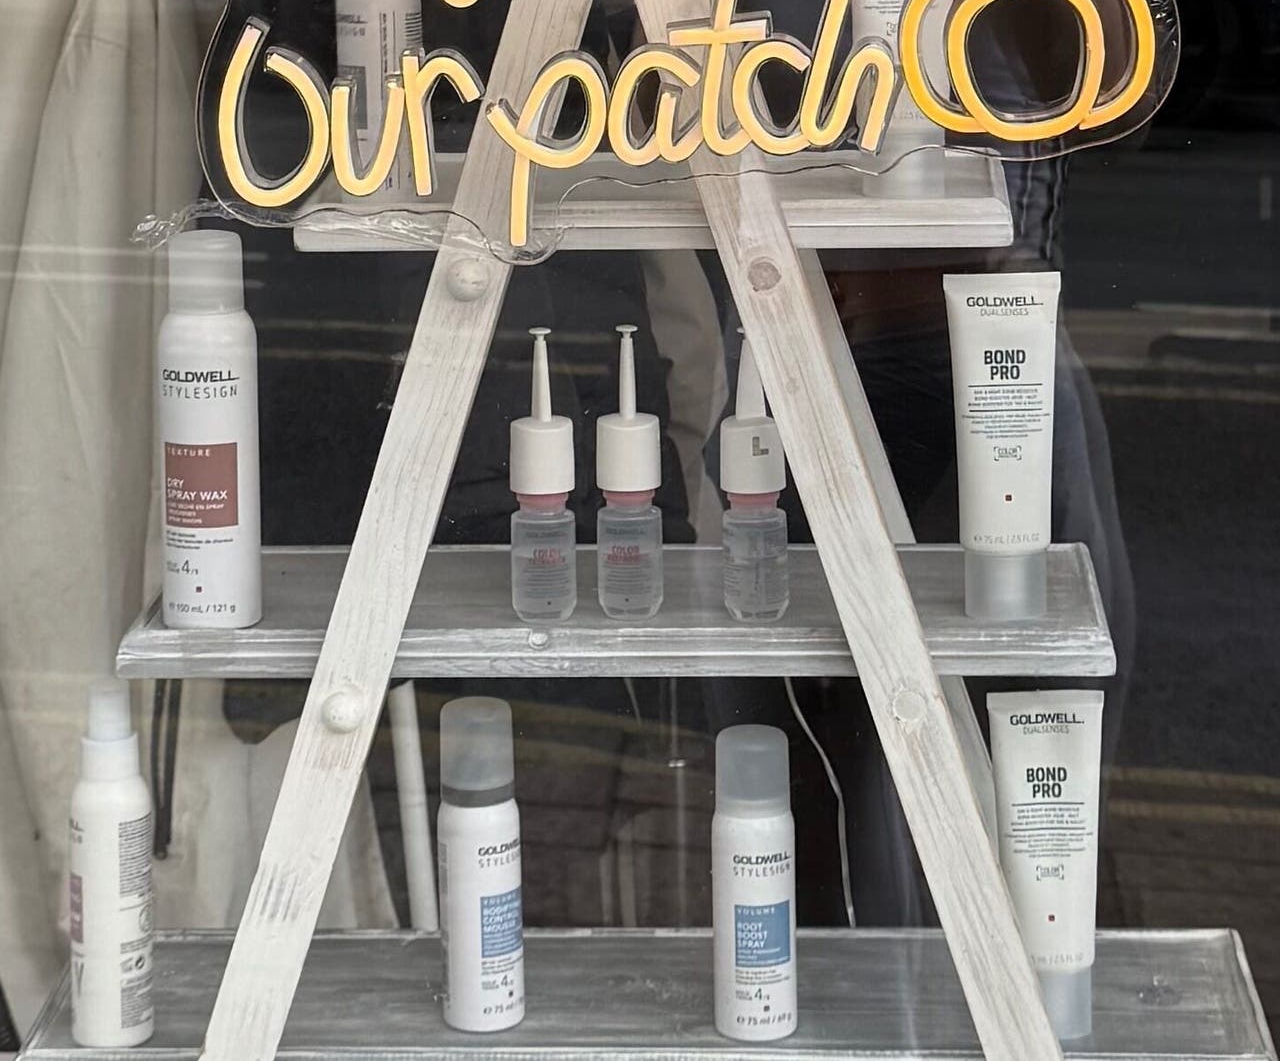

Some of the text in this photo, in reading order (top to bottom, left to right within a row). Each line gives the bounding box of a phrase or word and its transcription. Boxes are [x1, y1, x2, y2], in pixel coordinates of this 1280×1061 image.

[967, 296, 1043, 307] GOLDWELL
[984, 349, 1026, 365] BOND
[162, 368, 240, 383] GOLDWELL
[990, 365, 1020, 380] PRO
[162, 384, 237, 399] STYLESIGN
[167, 478, 184, 489] DRY
[167, 488, 228, 501] SPRAY WAX
[1010, 713, 1084, 726] GOLDWELL
[1026, 766, 1067, 783] BOND
[1033, 783, 1062, 798] PRO
[733, 851, 791, 865] GOLDWELL
